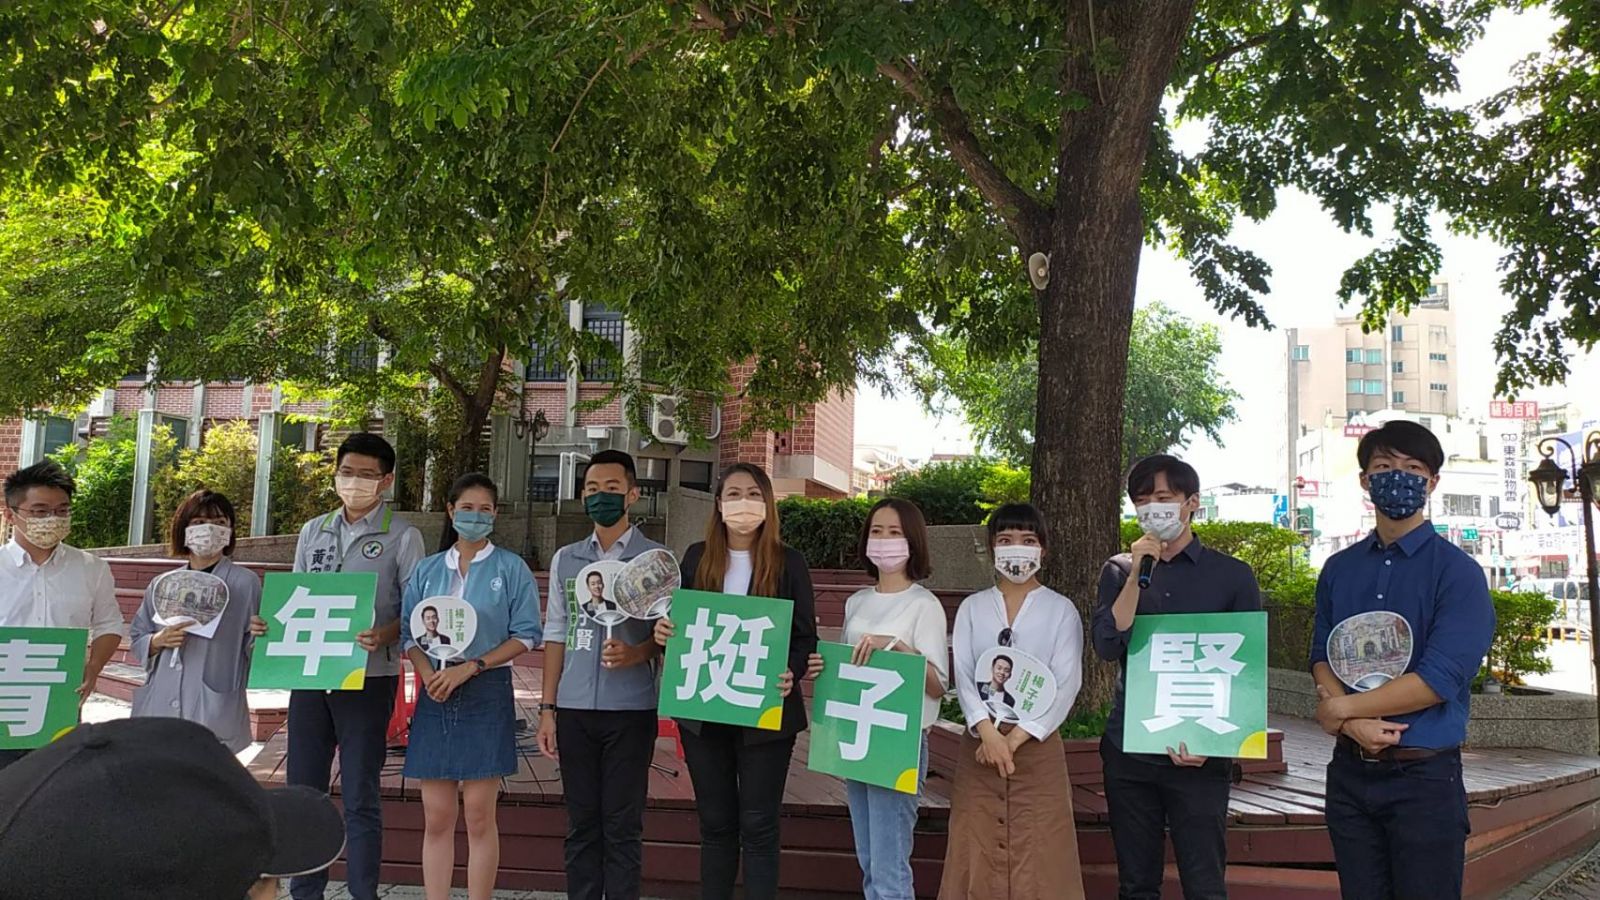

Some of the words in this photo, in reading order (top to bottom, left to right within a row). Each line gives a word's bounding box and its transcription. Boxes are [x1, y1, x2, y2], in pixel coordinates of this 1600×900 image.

[266, 585, 357, 676] 年
[455, 608, 465, 642] 楊子賢
[676, 607, 775, 708] 挺
[0, 639, 68, 737] 青
[825, 662, 908, 761] 子
[1022, 675, 1045, 712] 楊子賢
[1140, 632, 1247, 735] 賢
